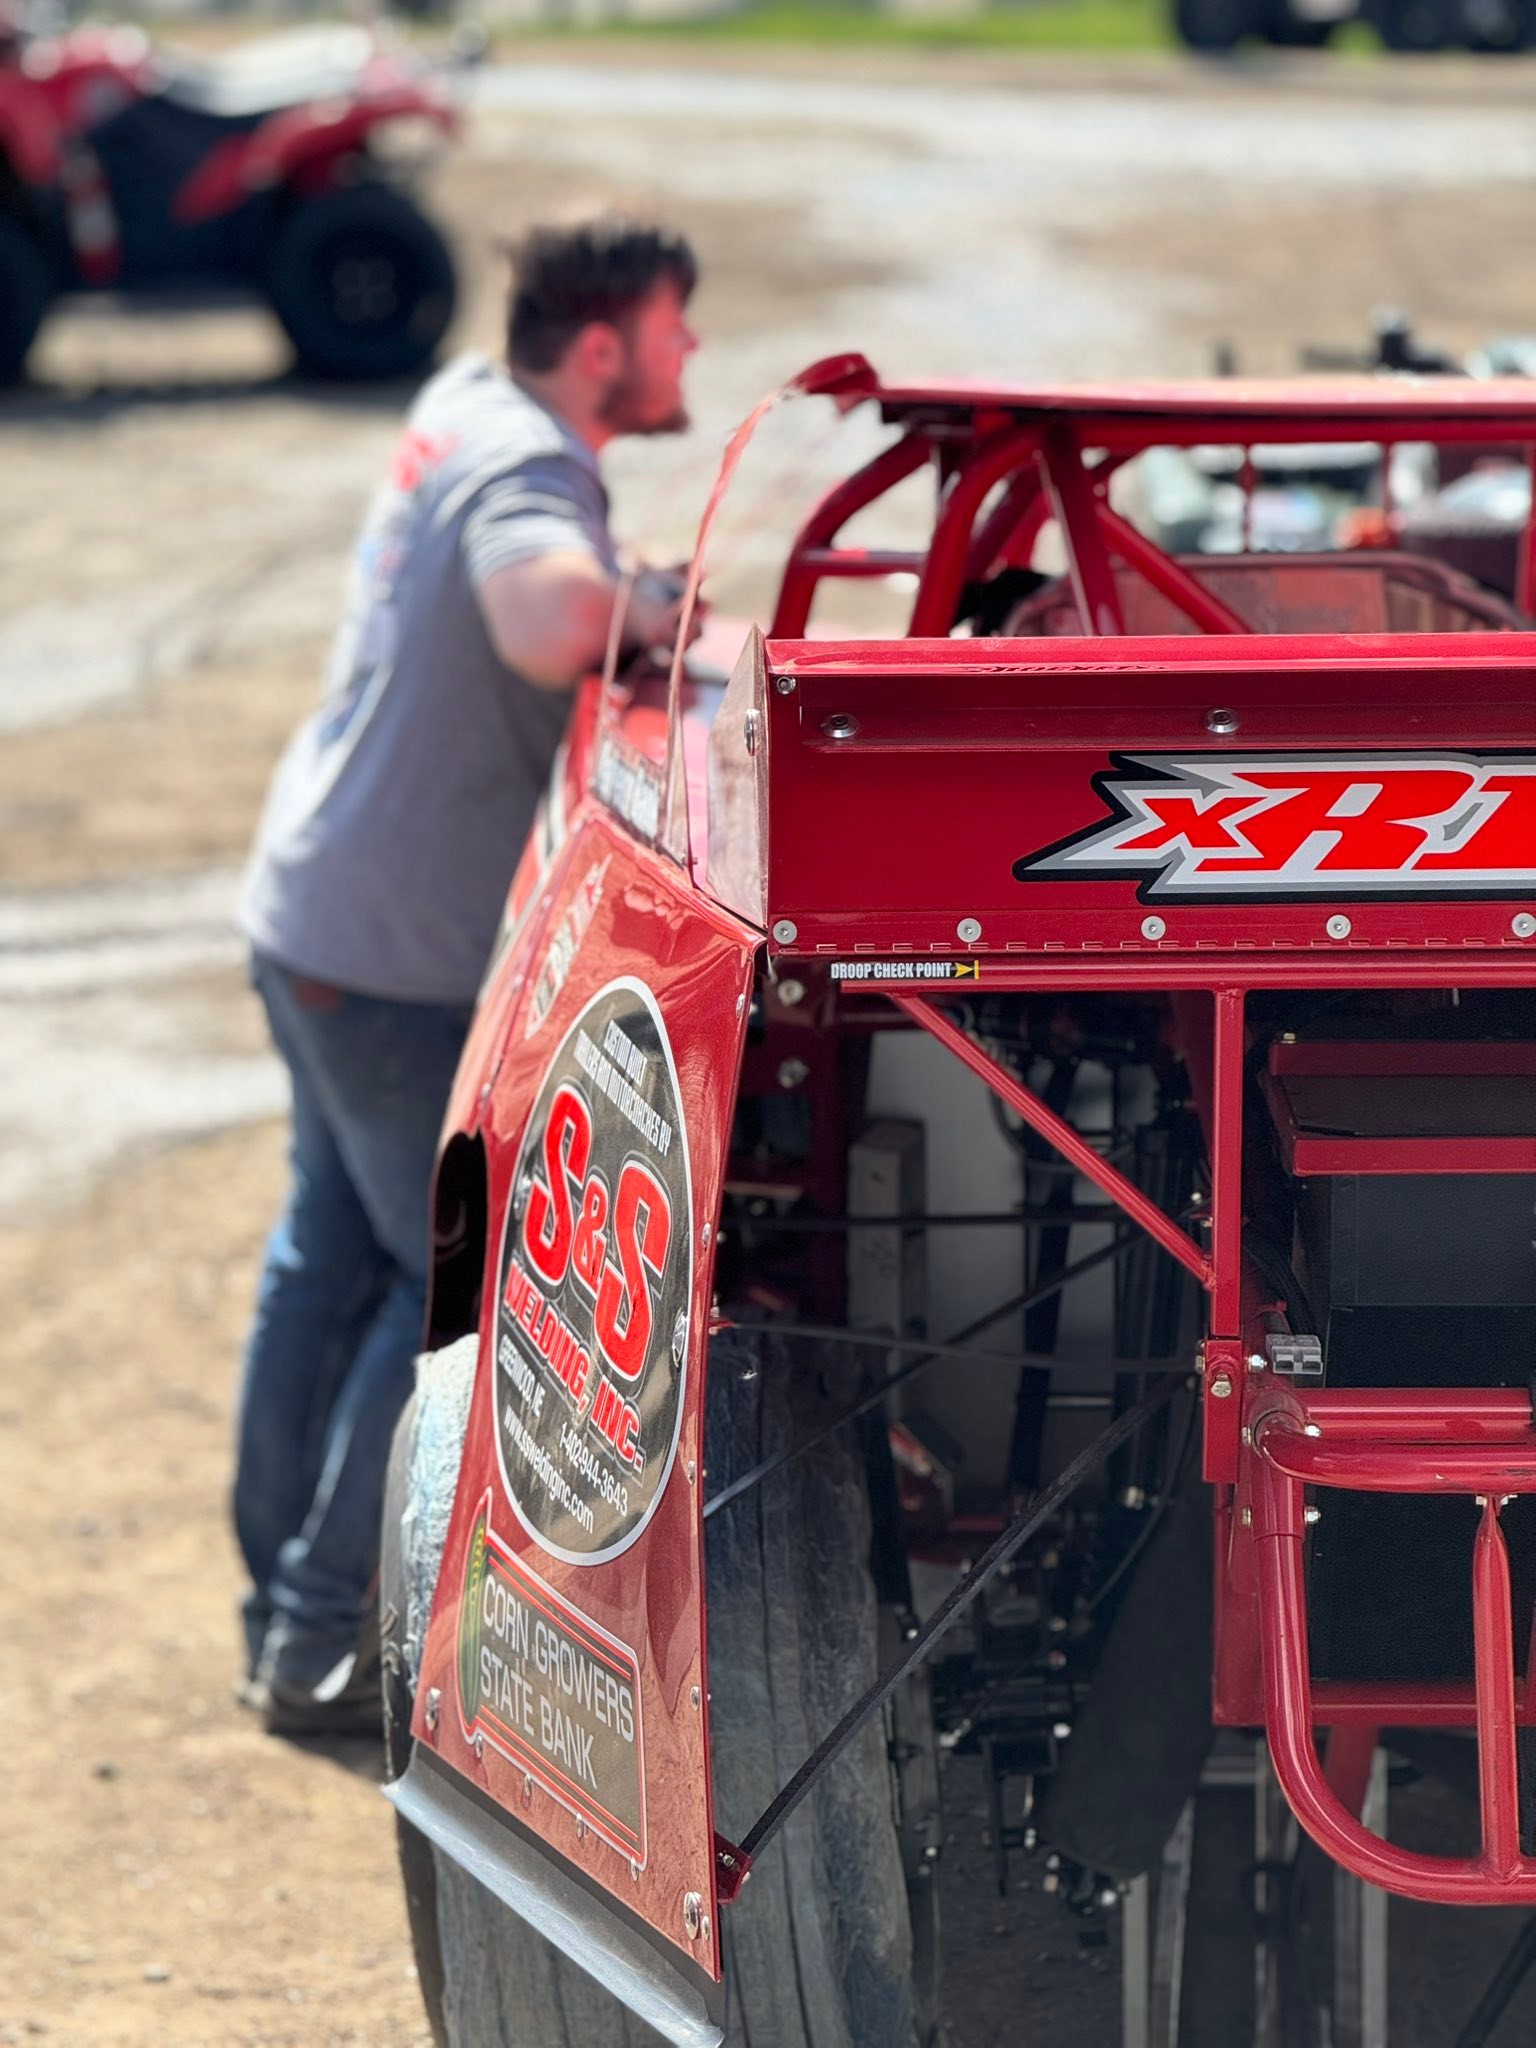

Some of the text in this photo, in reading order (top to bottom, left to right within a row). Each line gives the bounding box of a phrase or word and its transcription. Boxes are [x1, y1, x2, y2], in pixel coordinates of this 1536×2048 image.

[831, 962, 952, 979] DROOP CHECK POINT
[657, 1119, 672, 1157] BY
[504, 1404, 594, 1534] www.ssweldinginc.com
[560, 1422, 628, 1517] 1-402-944-3643
[591, 1374, 644, 1474] INC.
[483, 1574, 634, 1743] CORN GROWERS
[480, 1645, 597, 1789] STATE BANK
